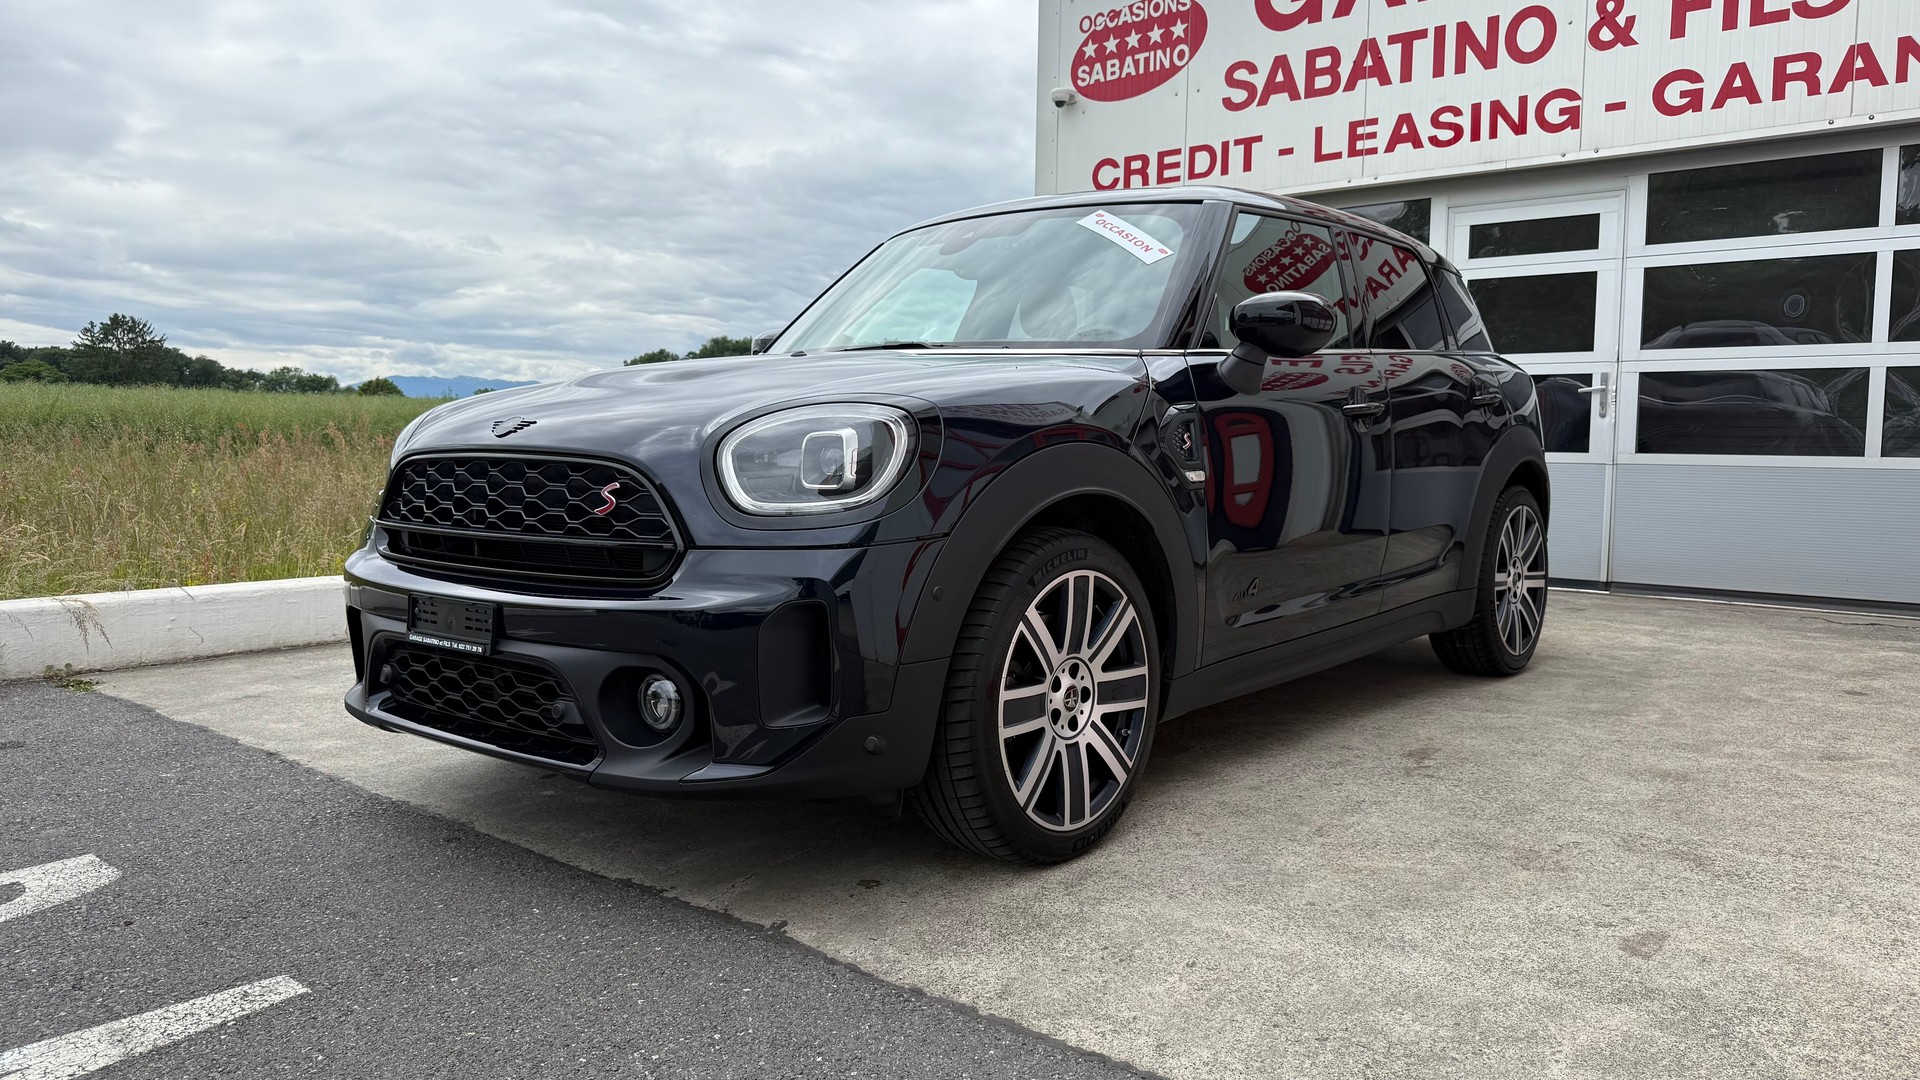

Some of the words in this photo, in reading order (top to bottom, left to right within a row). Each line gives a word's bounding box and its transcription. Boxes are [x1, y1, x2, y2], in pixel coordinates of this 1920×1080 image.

[1079, 0, 1191, 34] OCCASIONS
[1077, 44, 1190, 87] SABATINO
[1222, 4, 1558, 112] SABATINO
[1587, 0, 1639, 51] &
[1092, 135, 1263, 190] CREDIT
[1314, 87, 1582, 163] LEASING
[1095, 219, 1153, 253] OCCASION
[1032, 548, 1086, 584] MICHELIN
